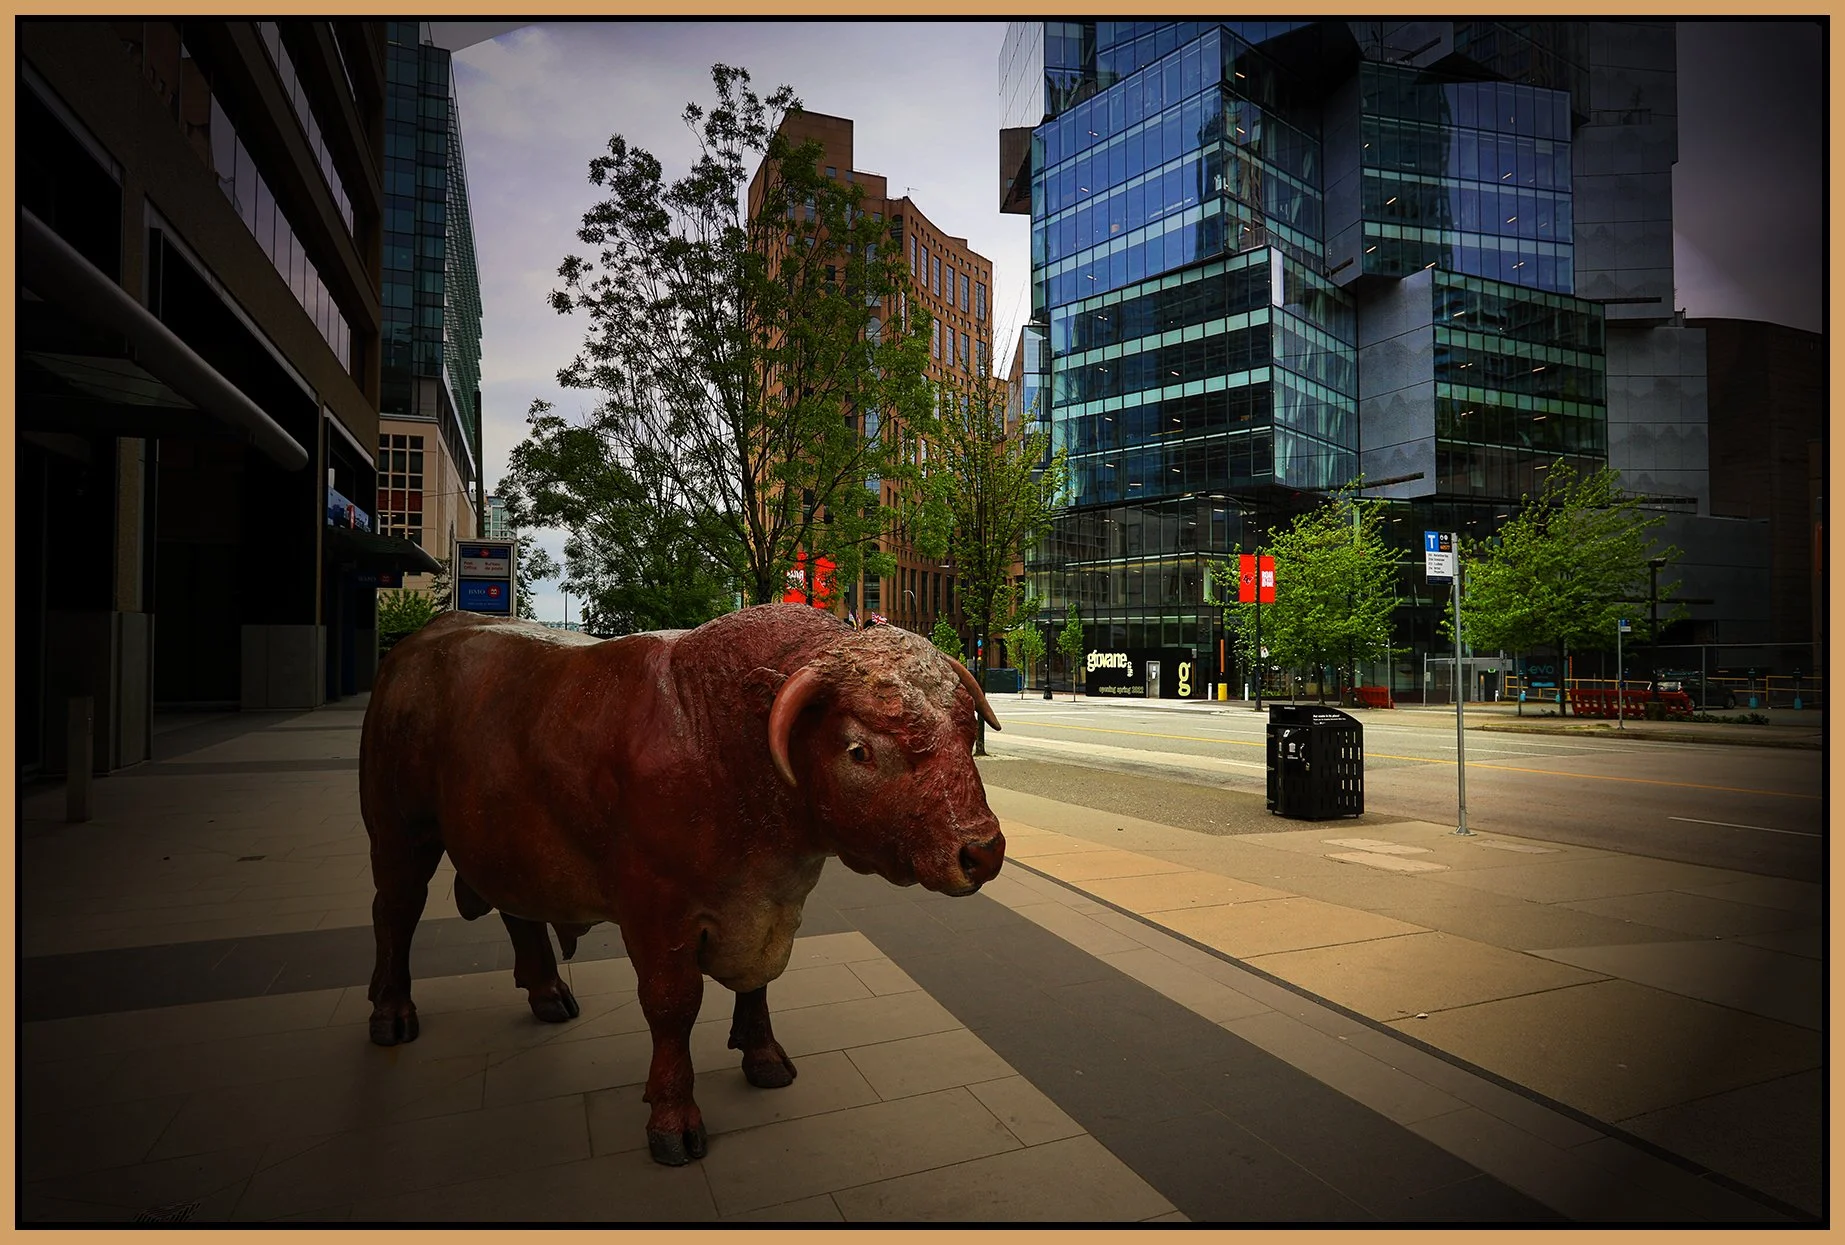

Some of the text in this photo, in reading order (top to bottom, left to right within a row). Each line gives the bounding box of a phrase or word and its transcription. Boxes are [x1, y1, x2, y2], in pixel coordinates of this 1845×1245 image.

[468, 588, 486, 596] BMO
[1087, 649, 1127, 672] giovane
[1178, 661, 1191, 697] g
